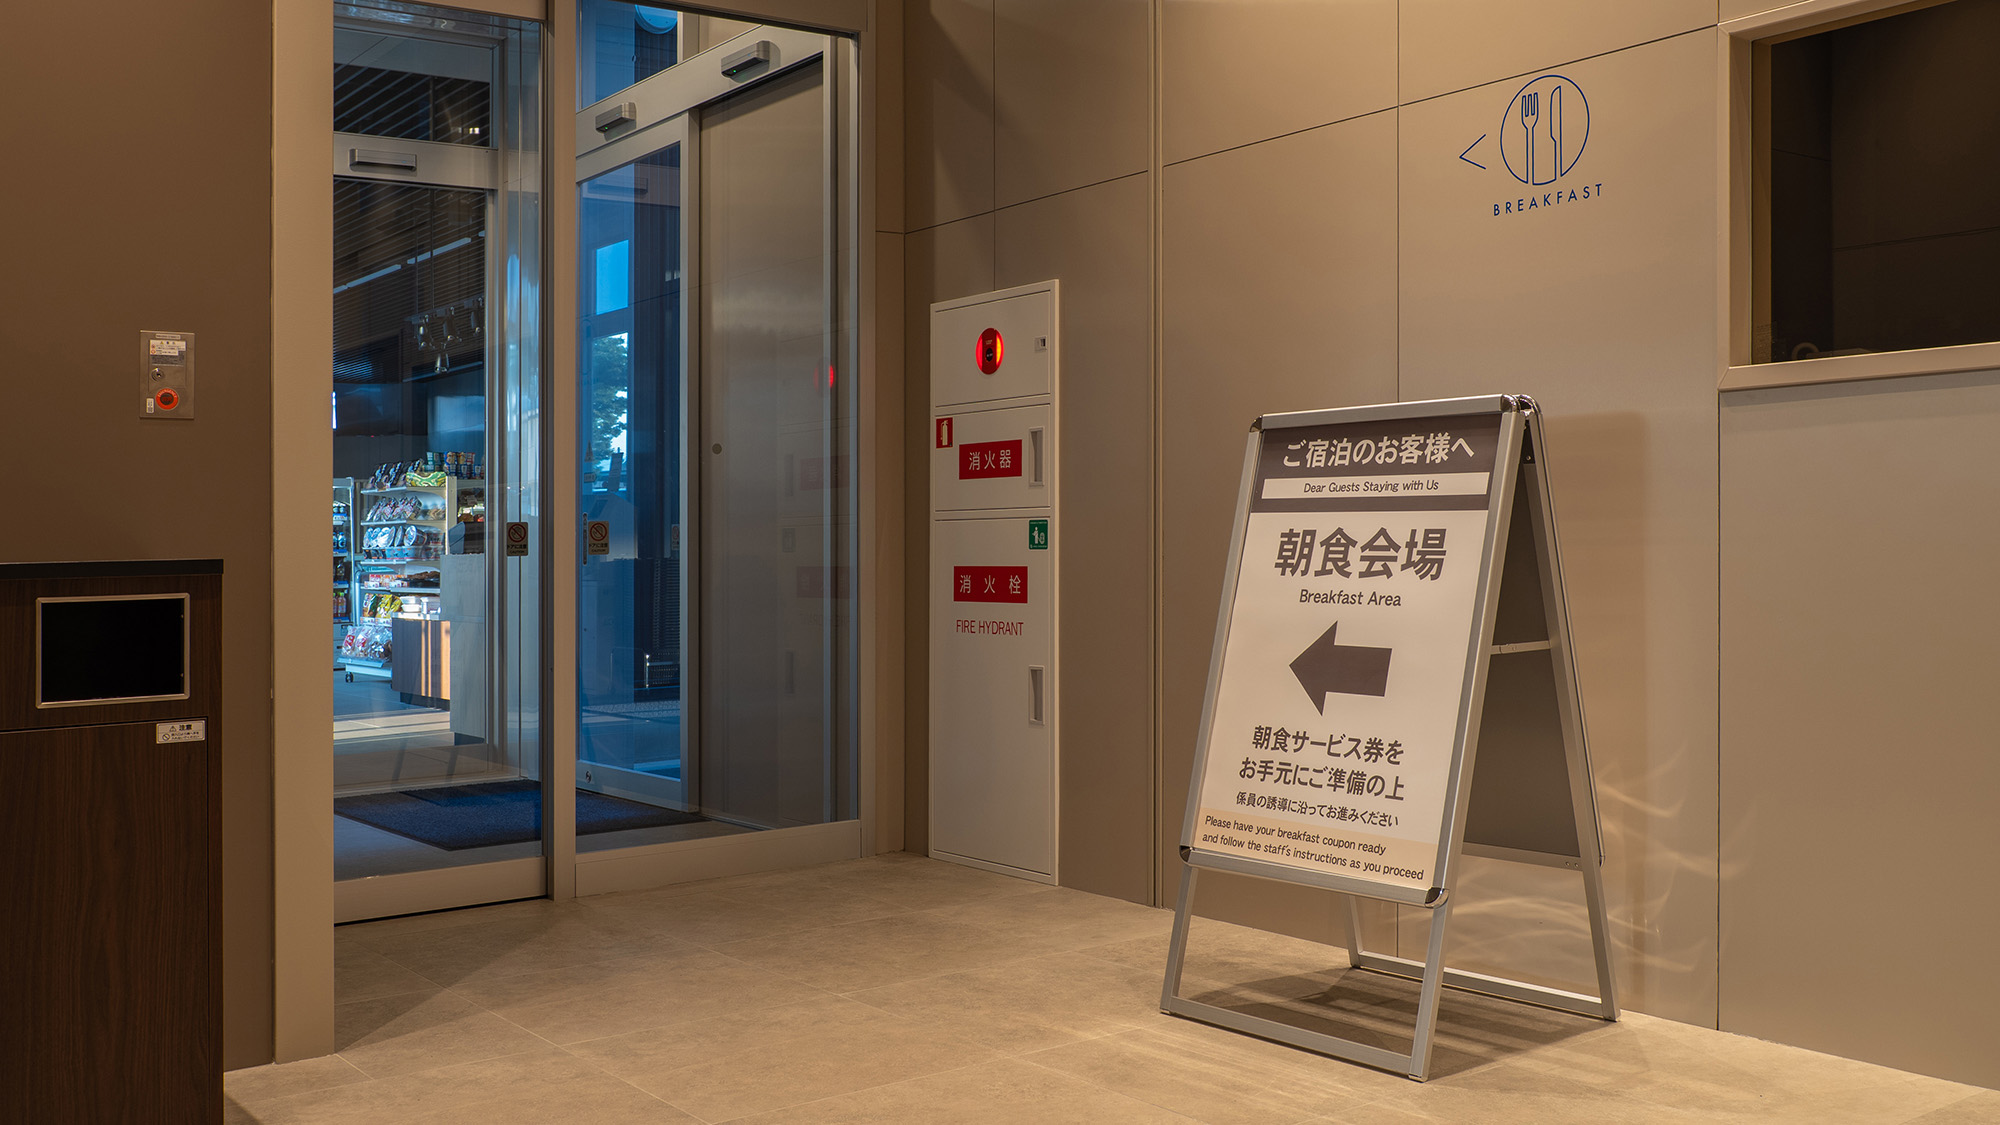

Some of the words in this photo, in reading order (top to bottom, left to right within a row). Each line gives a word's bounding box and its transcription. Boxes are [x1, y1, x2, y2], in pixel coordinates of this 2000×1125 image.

[1493, 183, 1603, 216] BREAKFAST
[968, 449, 1012, 471] 消火器
[1283, 431, 1475, 468] ご宿泊のお客様へ
[1304, 483, 1326, 493] Dear
[1328, 482, 1360, 492] Guests
[1363, 481, 1400, 492] Staying
[1402, 480, 1424, 490] with
[1426, 480, 1439, 490] Us
[1274, 526, 1447, 581] 朝食会場
[959, 574, 1021, 595] 消火栓
[1299, 588, 1363, 605] Breakfast
[1367, 591, 1402, 606] Area
[956, 620, 976, 634] FIRE
[978, 620, 1024, 636] HYDRANT
[1252, 725, 1404, 766] 朝食サービス券を
[1239, 756, 1405, 801] お手元にご準備の上
[1236, 791, 1399, 827] 係員の誘導に沿ってお進みください
[1205, 815, 1231, 829] Please
[1233, 820, 1253, 832] have
[1255, 825, 1276, 836] your
[1277, 827, 1320, 844] breakfast
[1322, 836, 1355, 850] coupon
[1358, 841, 1386, 856] ready
[1202, 834, 1218, 844] and
[1220, 834, 1245, 848] follow
[1248, 840, 1261, 851] the
[1264, 844, 1291, 857] staff's
[1293, 848, 1347, 867] instructions
[1350, 859, 1361, 869] as
[1363, 861, 1381, 873] you
[1383, 865, 1424, 881] proceed
